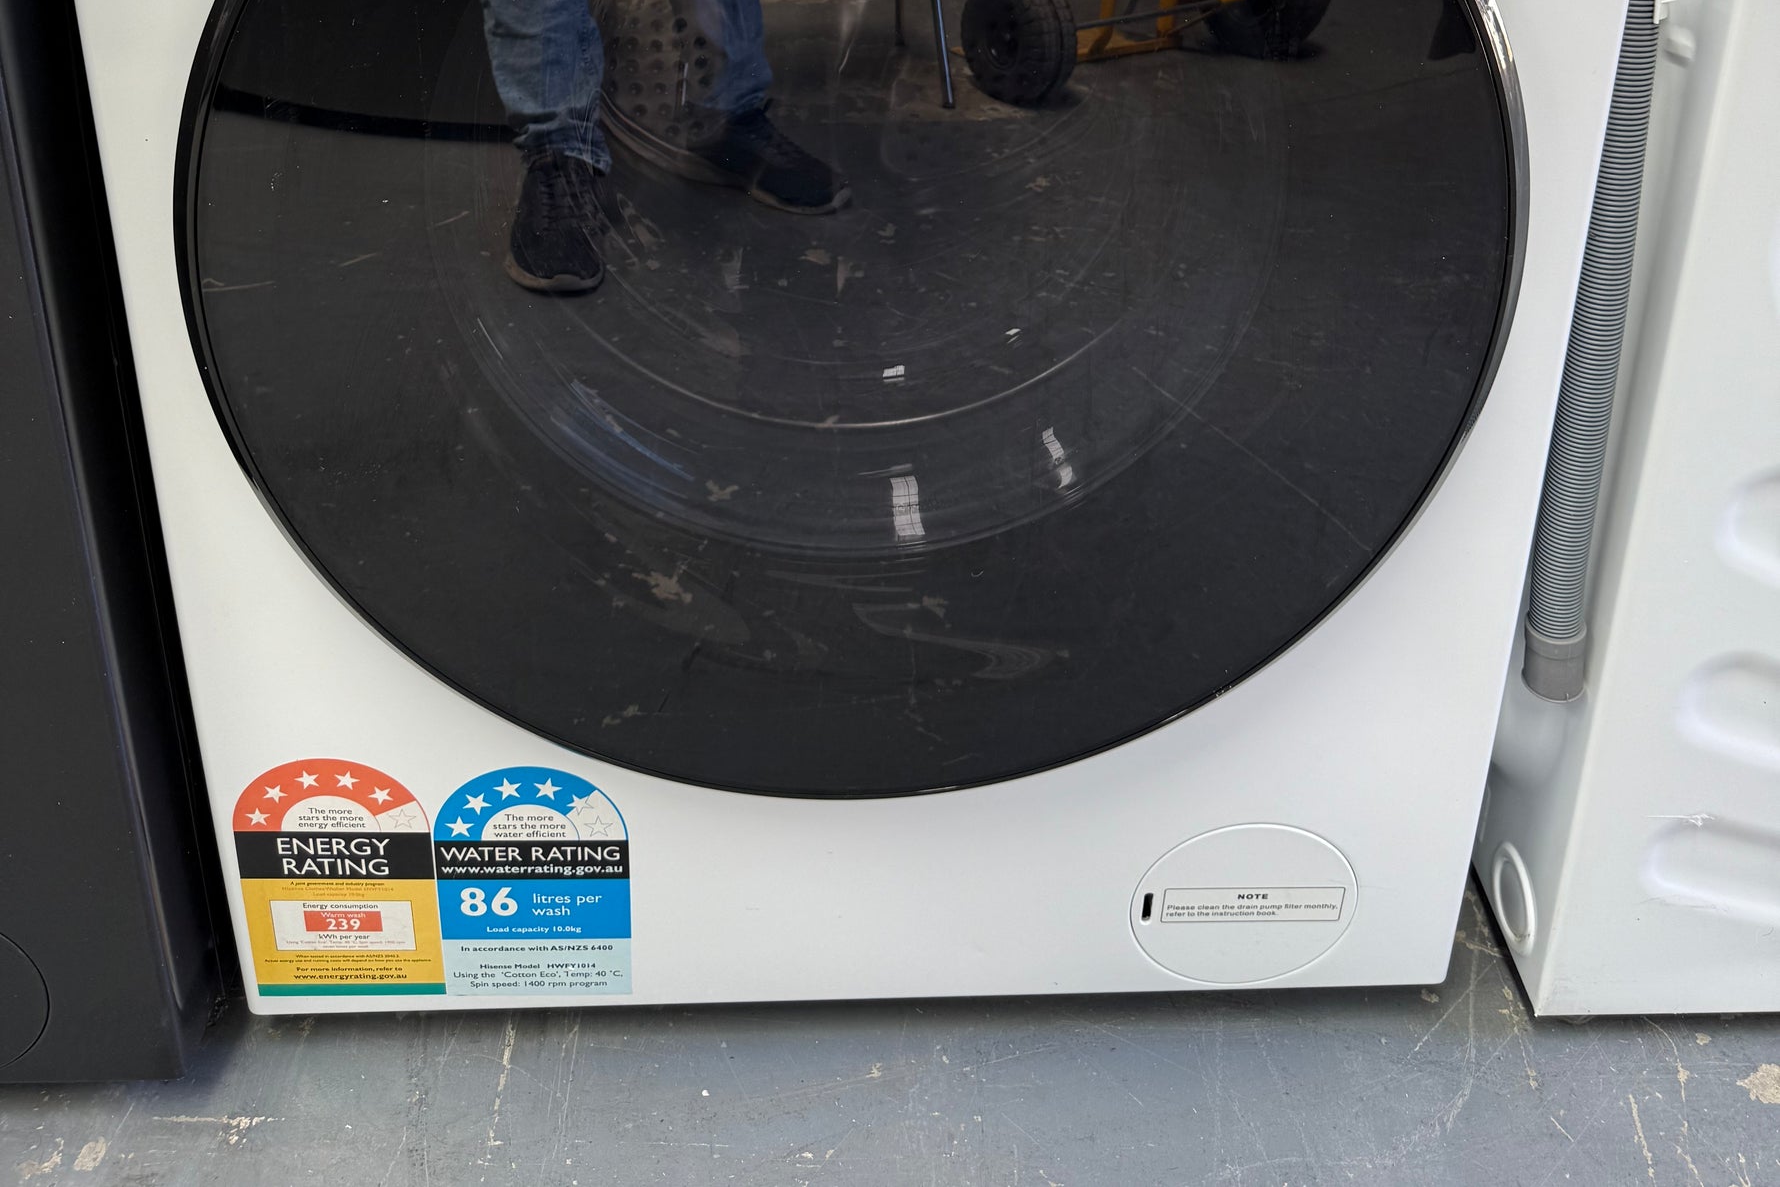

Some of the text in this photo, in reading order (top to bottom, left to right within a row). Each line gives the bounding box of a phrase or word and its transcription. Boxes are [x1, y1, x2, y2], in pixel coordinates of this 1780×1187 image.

[277, 838, 390, 855] ENERGY
[441, 846, 620, 861] WATER RATING
[283, 858, 389, 875] RATING
[441, 864, 622, 875] www.waterrating.gov.au
[461, 887, 518, 916] 86
[533, 893, 602, 906] litres per
[532, 905, 571, 916] wash
[326, 919, 360, 930] 239
[564, 970, 592, 978] Temp:
[492, 981, 520, 989] speed:
